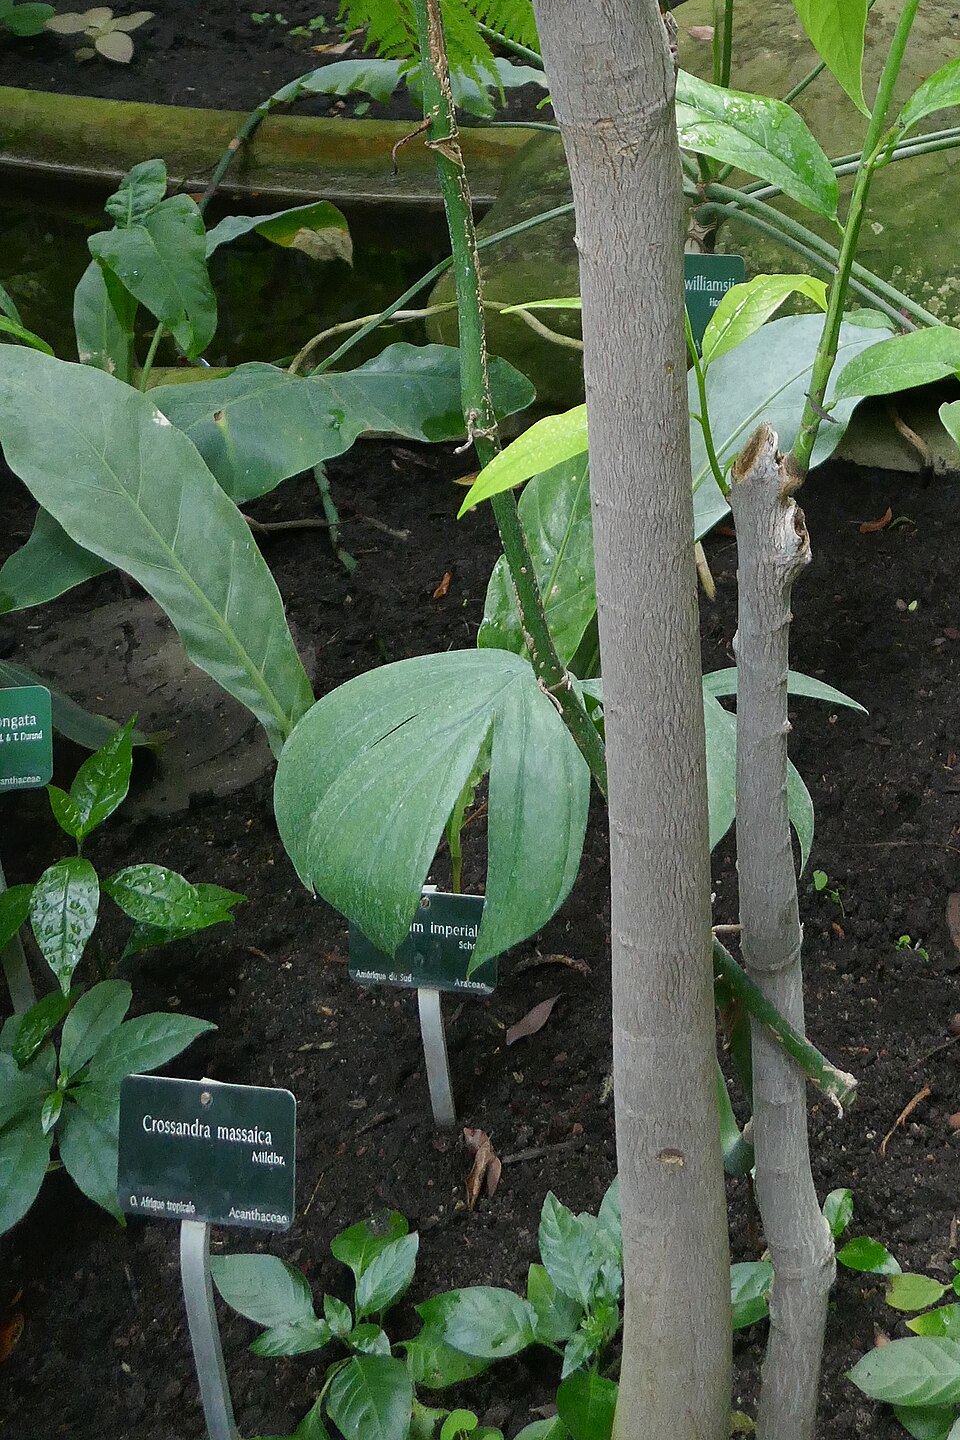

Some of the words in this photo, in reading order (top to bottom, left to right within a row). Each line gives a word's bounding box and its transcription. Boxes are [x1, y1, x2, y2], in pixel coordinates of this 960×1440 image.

[0, 775, 41, 786] anthaceae
[430, 921, 478, 938] imperial
[388, 971, 398, 981] du
[142, 1114, 211, 1138] Crossandra
[217, 1126, 272, 1145] massaica
[252, 1151, 286, 1166] Mildbr.
[166, 1200, 196, 1214] tropicale
[228, 1207, 288, 1225] Acanthaceae
